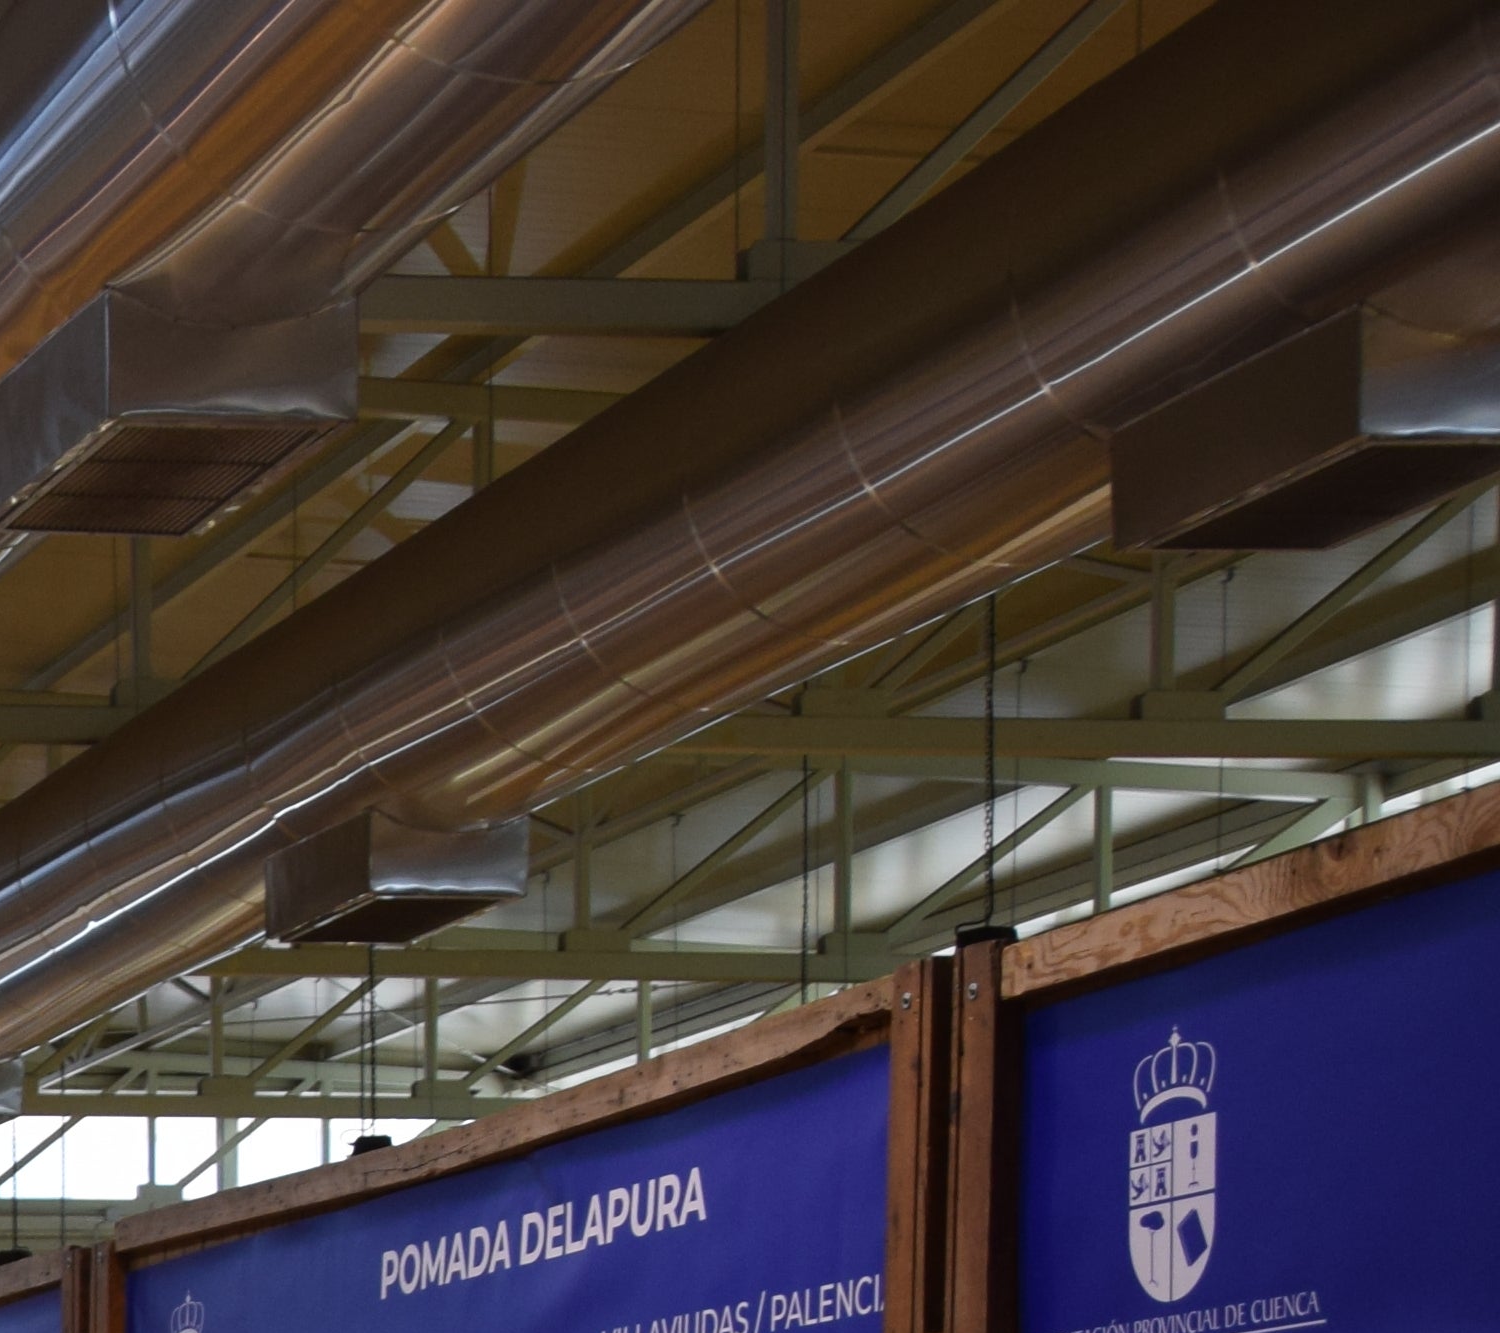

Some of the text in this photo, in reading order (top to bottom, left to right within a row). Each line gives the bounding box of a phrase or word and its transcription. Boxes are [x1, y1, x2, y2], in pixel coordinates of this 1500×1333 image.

[380, 1167, 707, 1300] POMADA DELAPURA
[770, 1273, 884, 1333] PALENCI
[1224, 1303, 1246, 1328] DE
[1251, 1290, 1320, 1323] CUENCA
